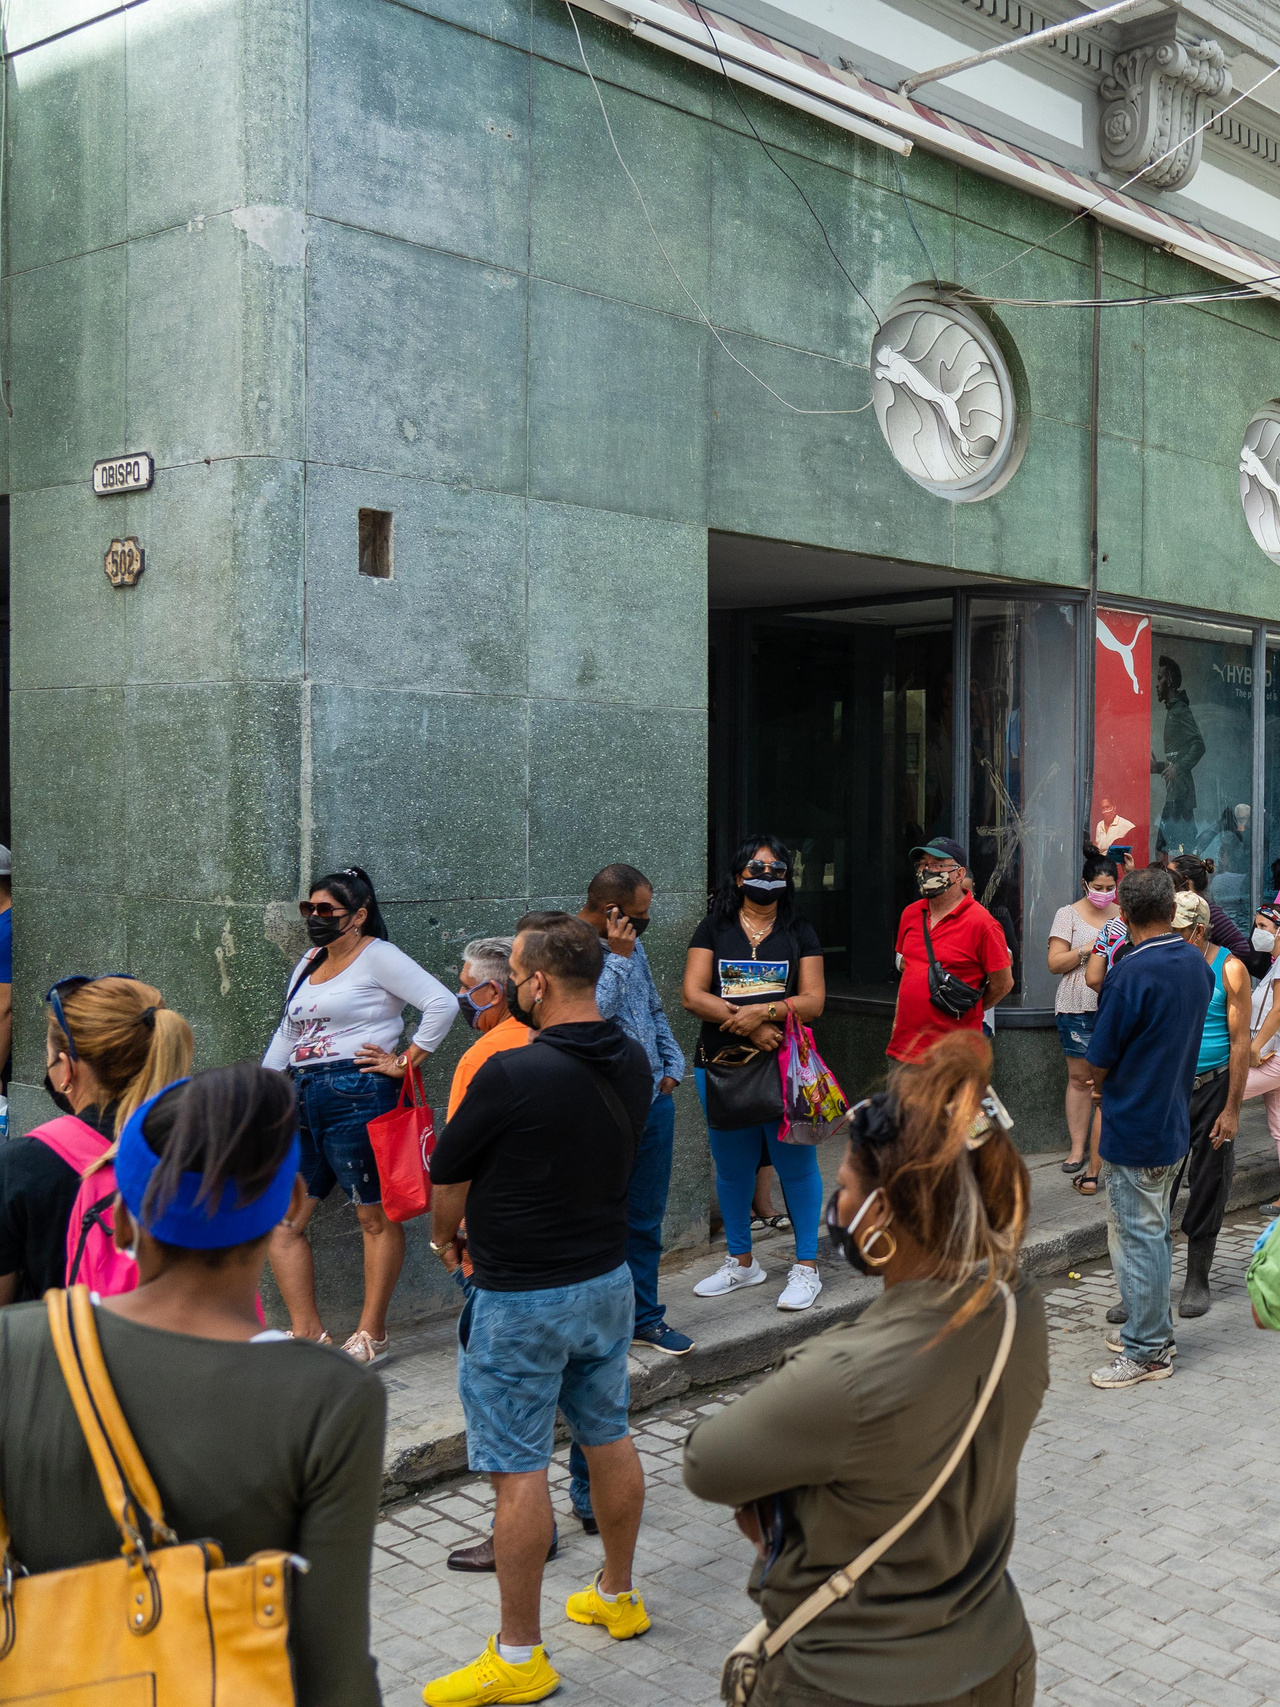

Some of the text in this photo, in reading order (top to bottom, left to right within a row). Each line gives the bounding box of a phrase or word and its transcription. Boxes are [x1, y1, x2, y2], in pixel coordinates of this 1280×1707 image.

[101, 460, 140, 487] OBISPO
[111, 548, 135, 577] 502
[1227, 664, 1272, 687] HYBD
